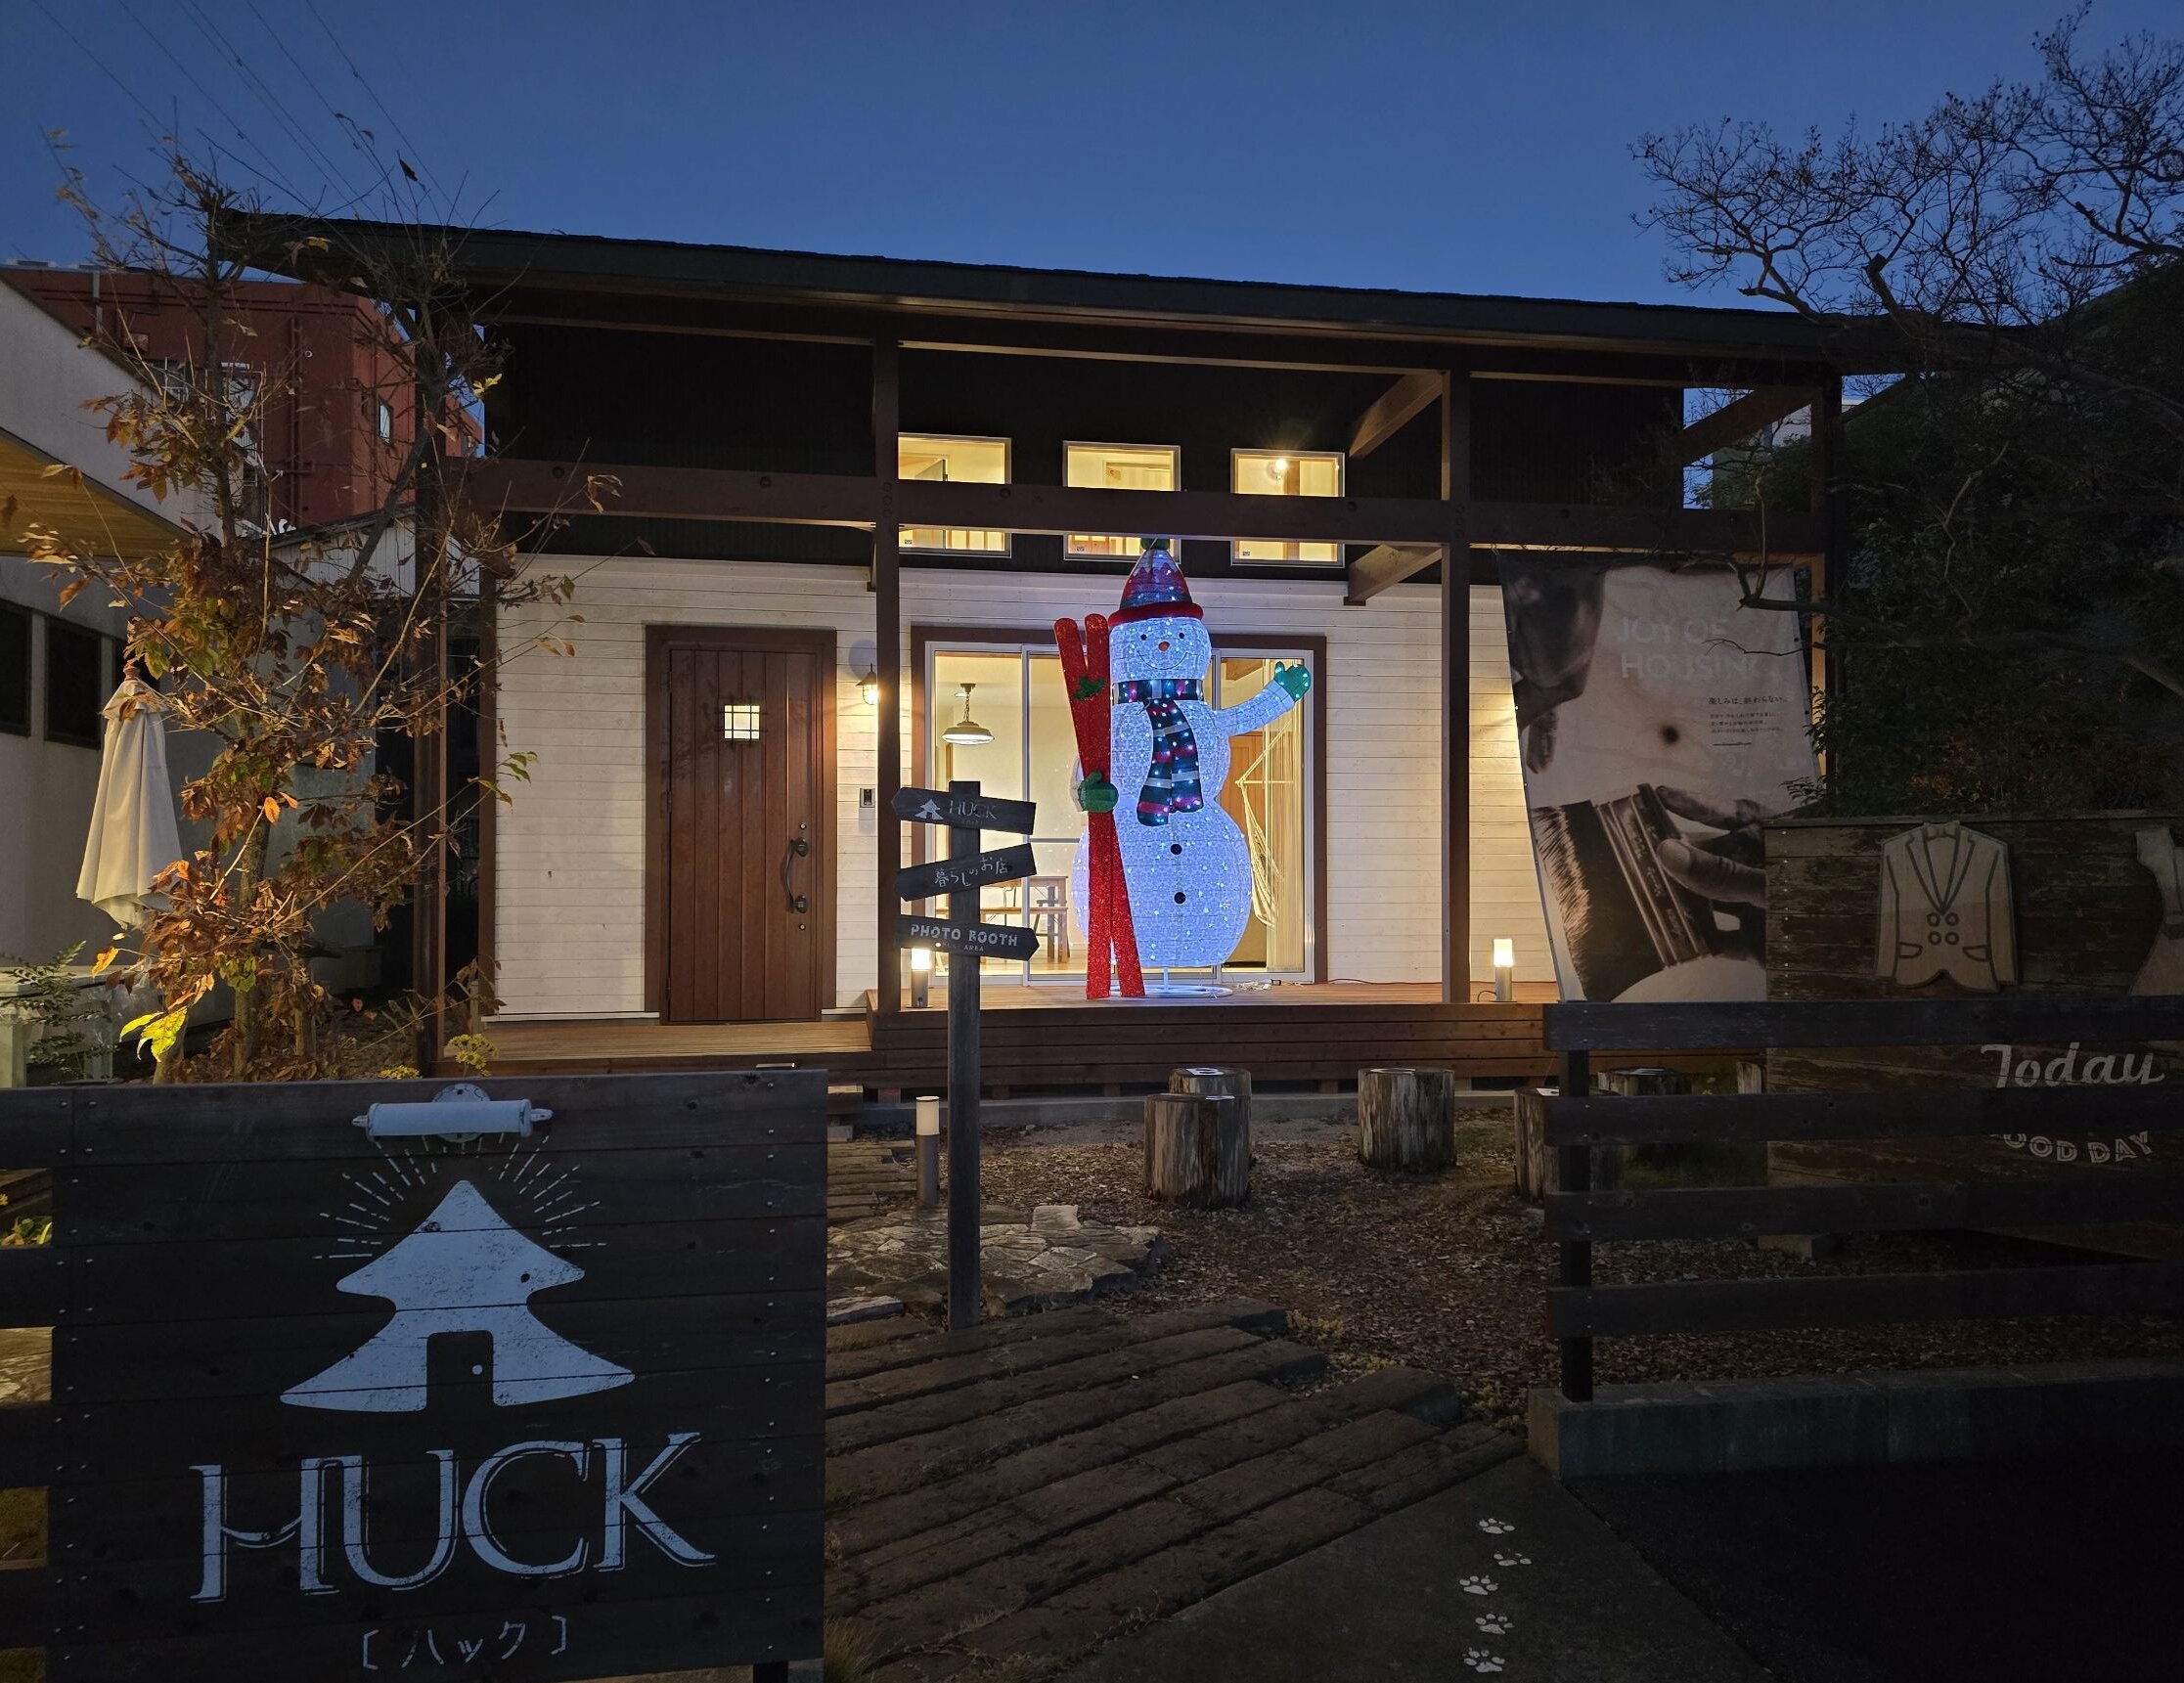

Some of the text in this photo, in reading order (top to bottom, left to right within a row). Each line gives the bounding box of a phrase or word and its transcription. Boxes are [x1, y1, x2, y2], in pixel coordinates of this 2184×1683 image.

[950, 800, 997, 819] HUCK
[934, 857, 1007, 887] 暮らしのお店
[911, 924, 960, 940] PHOTO
[1980, 1041, 2166, 1088] Today
[1989, 1129, 2154, 1164] OOD DAY
[190, 1432, 717, 1603] HUCK
